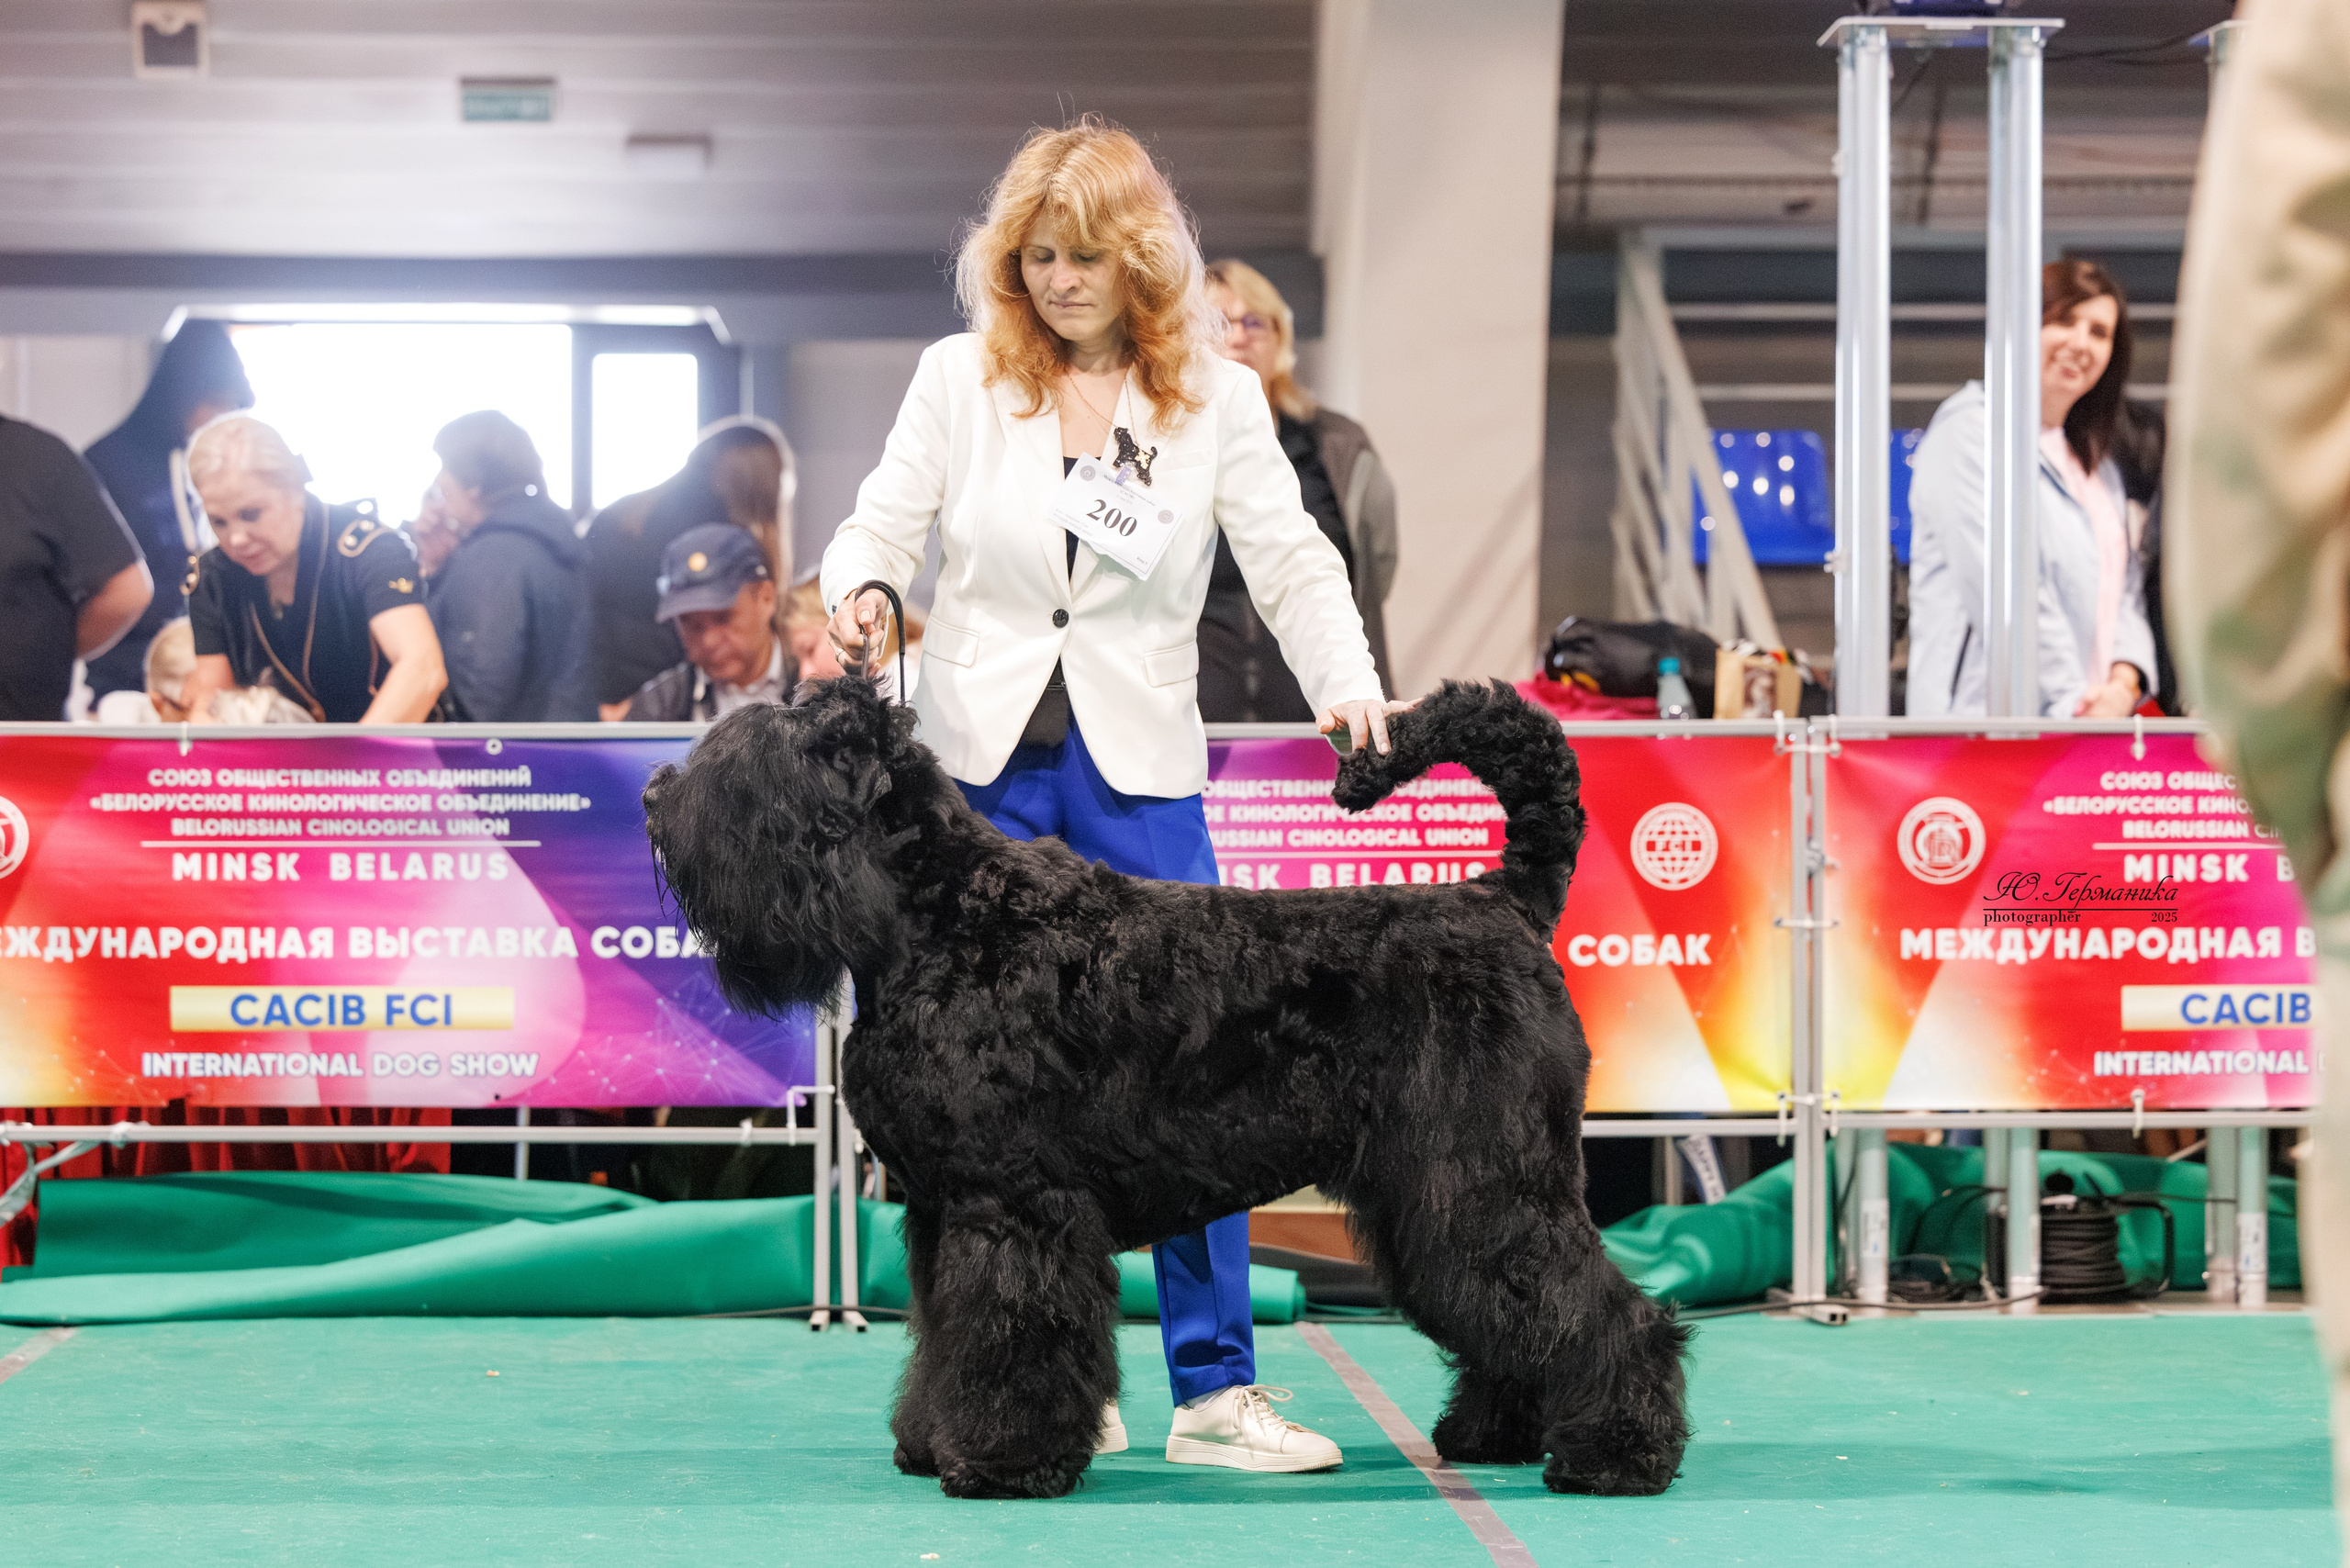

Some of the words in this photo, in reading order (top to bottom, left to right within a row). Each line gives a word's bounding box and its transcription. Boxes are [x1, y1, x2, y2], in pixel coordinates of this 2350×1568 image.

[1085, 498, 1138, 537] 200
[148, 768, 212, 787] СОЮЗ
[217, 768, 381, 789] ОБЩЕСТВЕННЫХ
[386, 765, 532, 789] ОБЪЕДИНЕНИЙ
[2100, 771, 2164, 790] СОЮЗ
[91, 793, 243, 812] «БЕЛОРУССКОЕ
[248, 793, 432, 812] КИНОЛОГИЧЕСКОЕ
[437, 793, 591, 813] ОБЪЕДИНЕНИЕ»
[2042, 796, 2193, 815] «БЕЛОРУССКОЕ
[171, 818, 302, 836] BELORUSSIAN
[307, 818, 442, 836] CINOLOGICAL
[447, 818, 510, 836] UNION
[1287, 828, 1422, 846] CINOLOGICAL
[1425, 828, 1489, 846] UNION
[2122, 820, 2248, 838] BELORUSSIAN
[172, 852, 301, 881] MINSK
[329, 852, 509, 881] BELARUS
[1310, 861, 1487, 889] BELARUS
[2123, 854, 2249, 883] MINSK
[0, 925, 334, 963] ЖДУНАРОДНАЯ
[348, 926, 578, 958] ВЫСТАВКА
[1568, 934, 1711, 967] СОБАК
[1900, 926, 2282, 965] МЕЖДУНАРОДНАЯ
[229, 993, 366, 1026] CACIB
[385, 993, 453, 1026] FCI
[2180, 992, 2312, 1025] CACIB
[141, 1052, 364, 1077] INTERNATIONAL
[373, 1052, 441, 1077] DOG
[450, 1052, 539, 1077] SHOW
[2094, 1051, 2310, 1076] INTERNATIONAL
